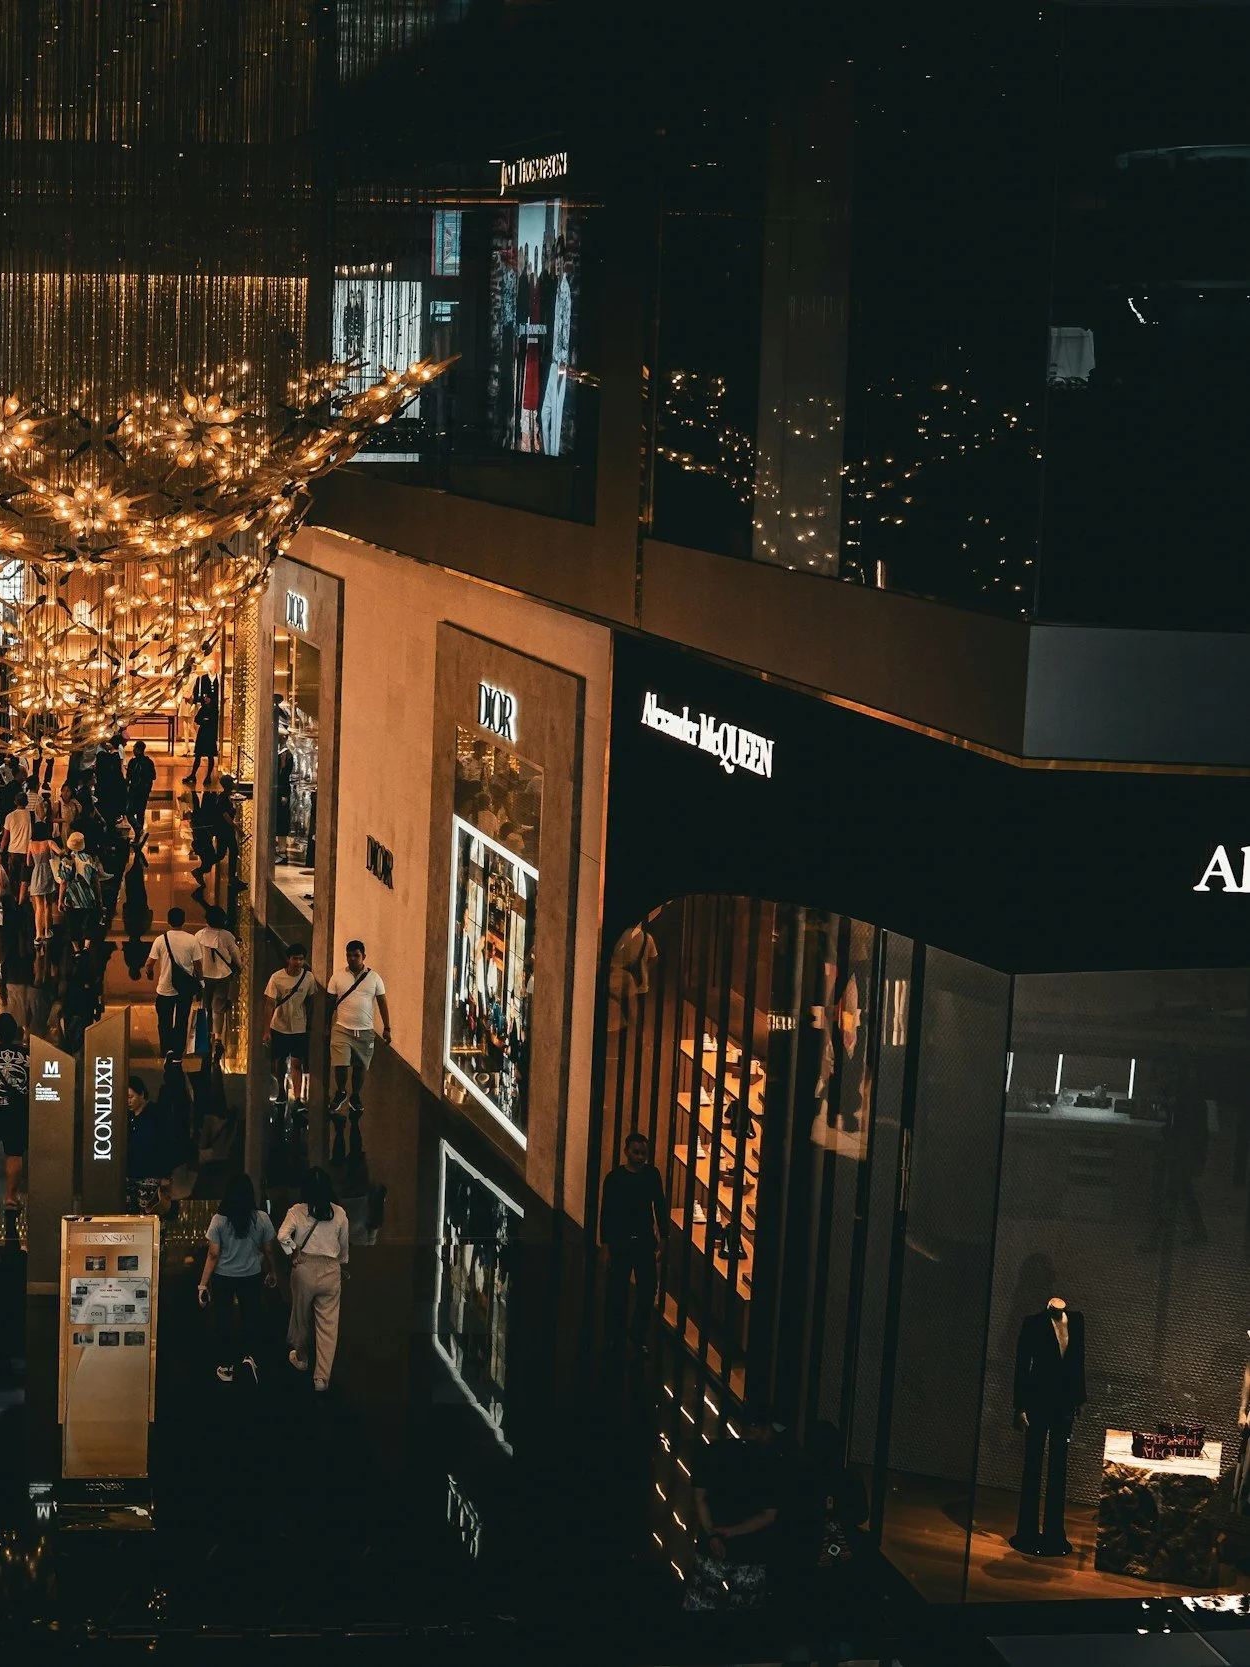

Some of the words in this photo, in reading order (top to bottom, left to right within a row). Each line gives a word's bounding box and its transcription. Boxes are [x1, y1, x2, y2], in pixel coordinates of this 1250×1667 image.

[478, 682, 513, 741] DIOR
[698, 712, 775, 778] McQUEEN
[365, 834, 394, 890] DIOR
[93, 1056, 114, 1161] ICONLUXE
